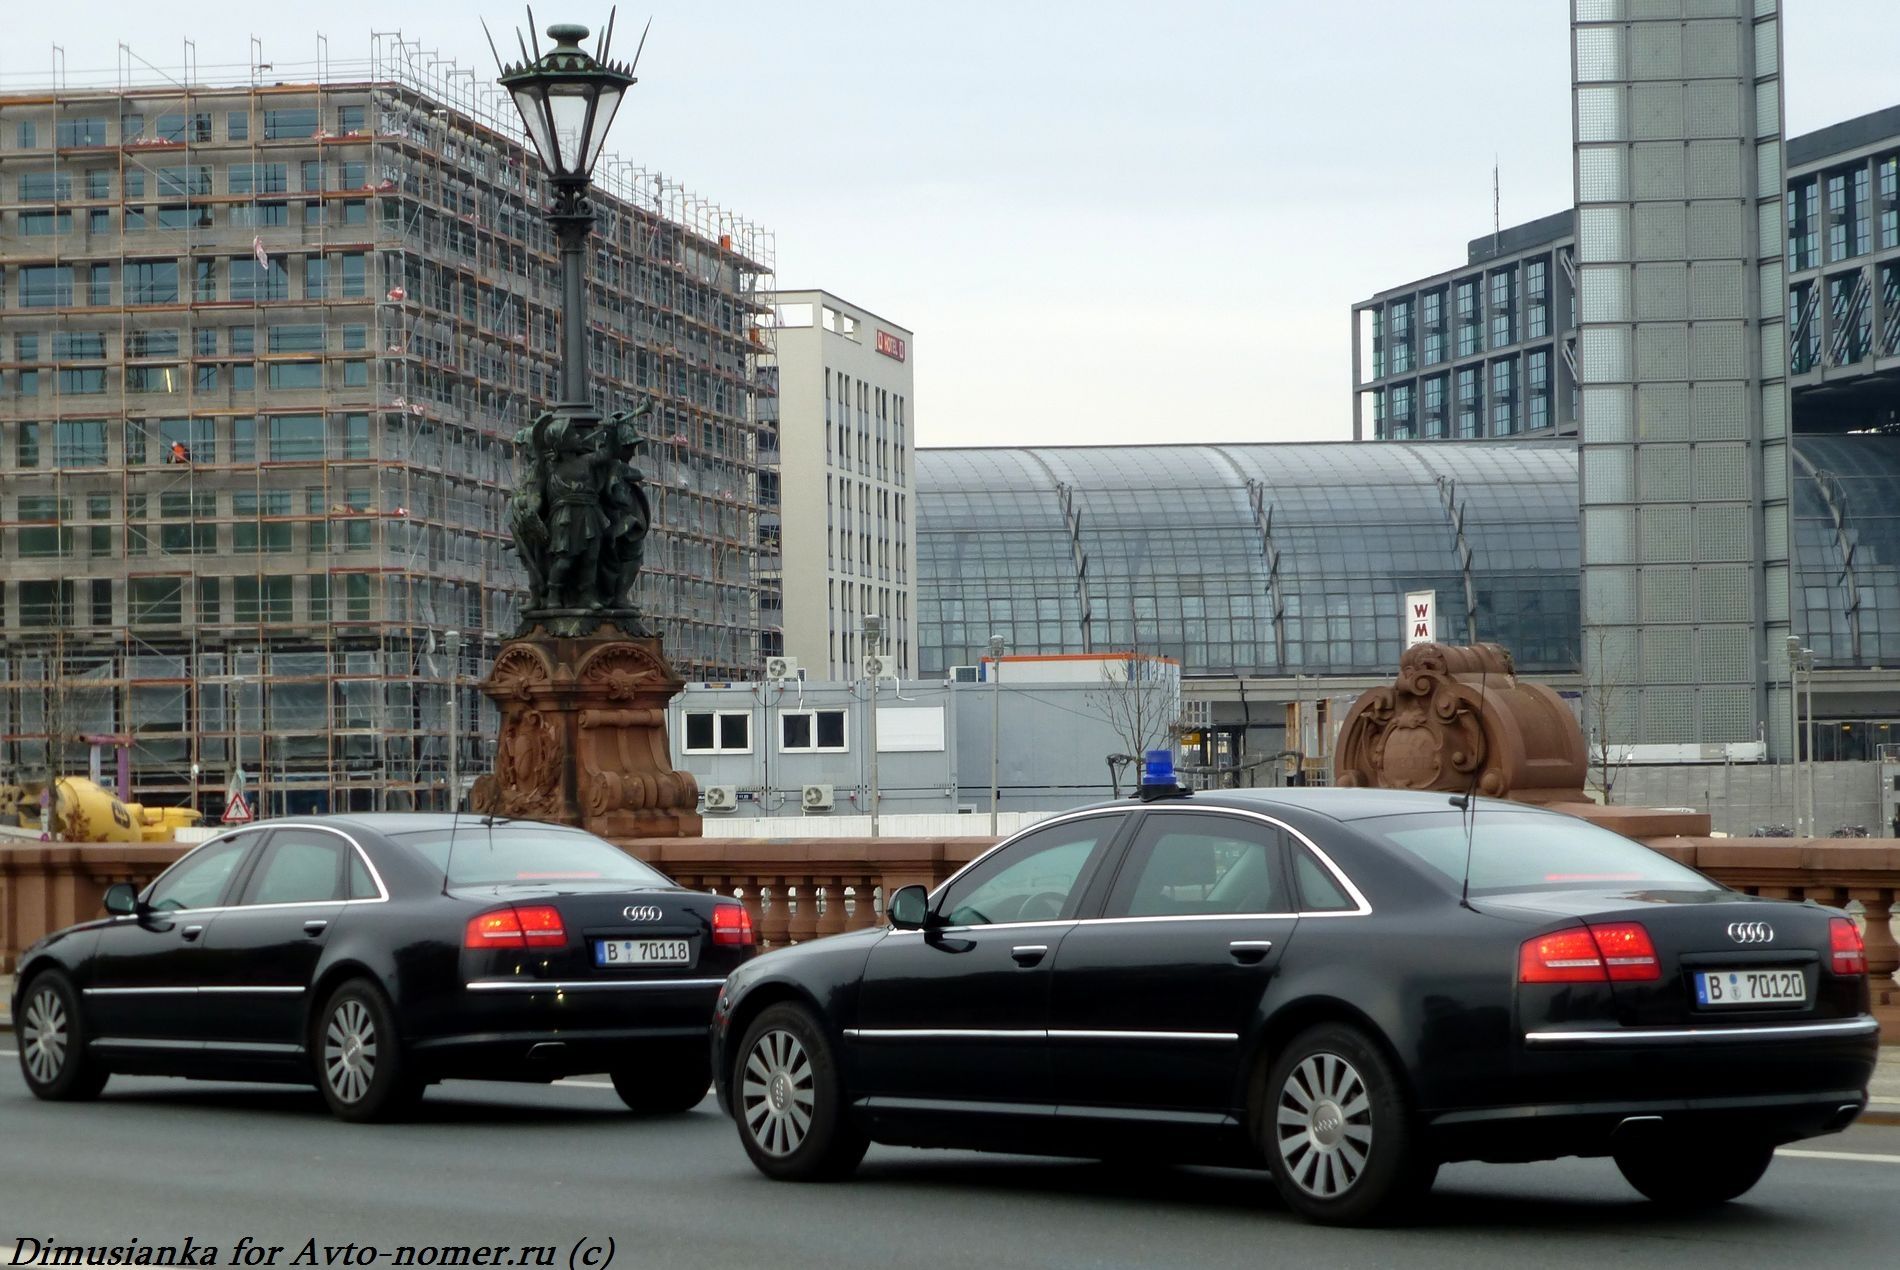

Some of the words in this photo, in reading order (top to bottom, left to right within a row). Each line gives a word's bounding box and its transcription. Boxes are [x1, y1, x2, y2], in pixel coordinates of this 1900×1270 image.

[1414, 604, 1428, 618] W
[1414, 623, 1428, 637] M
[607, 943, 618, 961] B
[639, 942, 687, 961] 70118
[1709, 975, 1722, 1000] B
[1747, 973, 1802, 999] 70120
